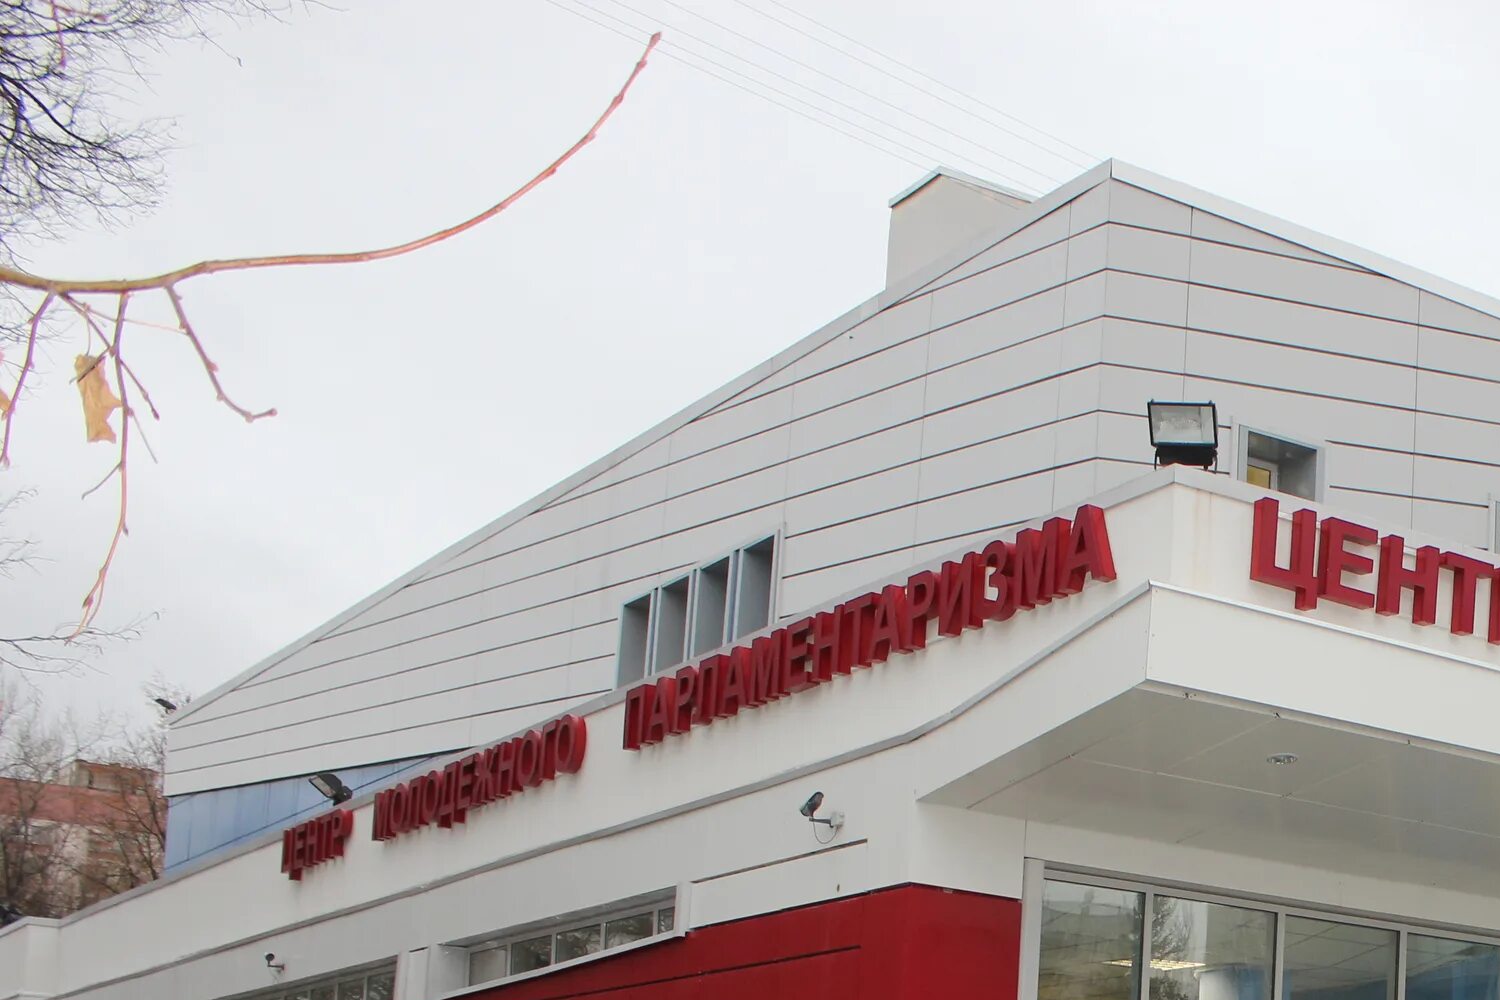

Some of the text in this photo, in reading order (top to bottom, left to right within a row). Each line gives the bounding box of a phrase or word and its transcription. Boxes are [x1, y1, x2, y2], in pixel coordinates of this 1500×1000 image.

[282, 504, 1117, 880] ЦЕНТР МОЛОДЕЖНОГО ПАРЛАМЕНТАРИЗМА
